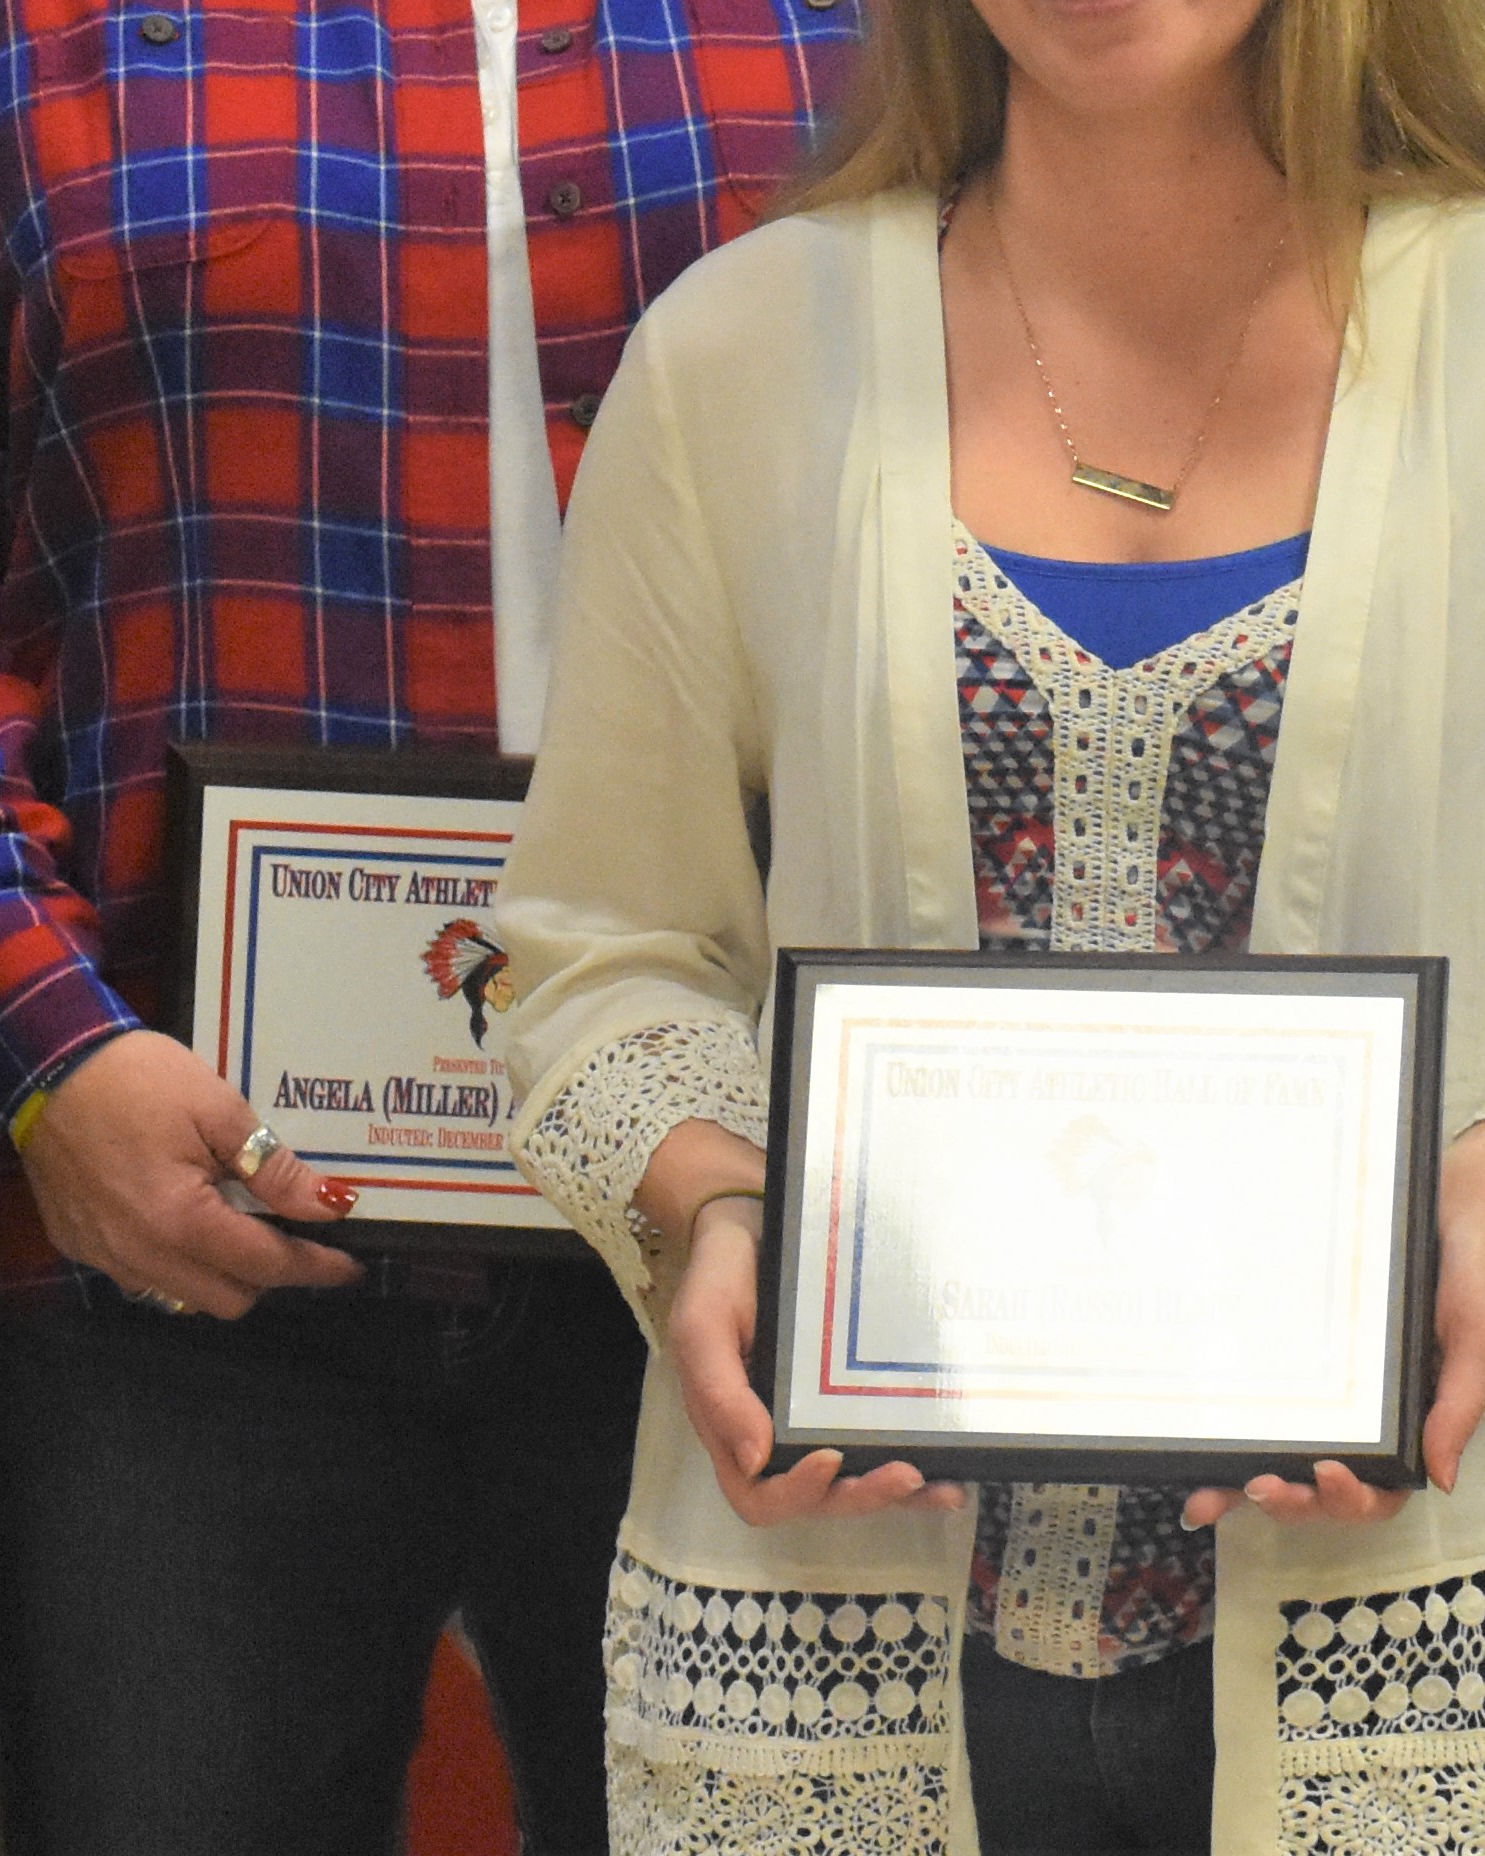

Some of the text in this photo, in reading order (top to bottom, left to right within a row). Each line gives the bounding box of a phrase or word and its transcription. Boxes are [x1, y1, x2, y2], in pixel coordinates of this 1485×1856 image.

[271, 863, 498, 908] UNION CITY ATHLET
[273, 1070, 500, 1126] ANGELA (MILLER)
[886, 1061, 960, 1099] UNION
[967, 1063, 1024, 1100] CITY
[1031, 1066, 1146, 1103] ATHLETIC
[1154, 1069, 1217, 1105] HALL
[1264, 1070, 1325, 1107] FAME
[367, 1124, 503, 1150] INDUCTED: DECEMBER
